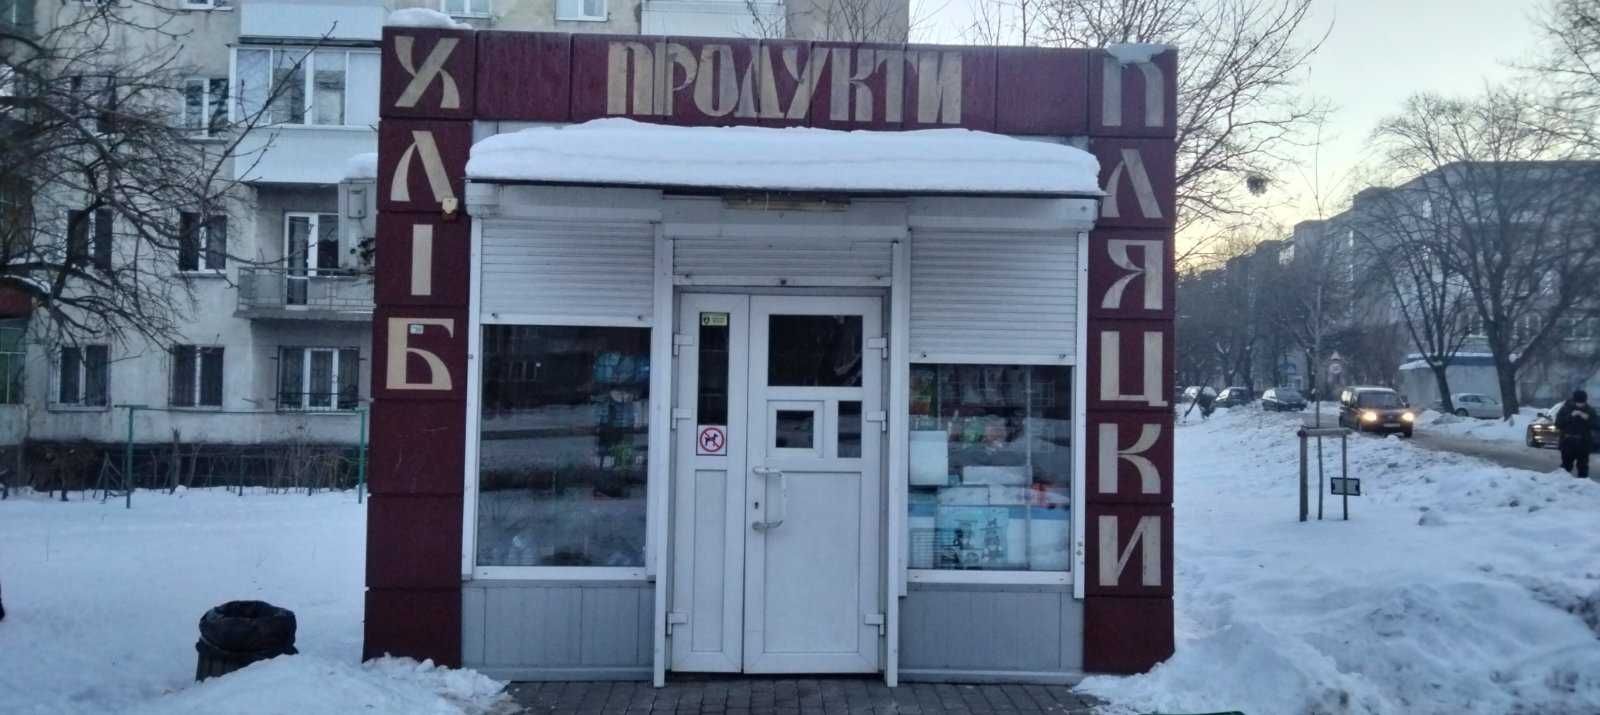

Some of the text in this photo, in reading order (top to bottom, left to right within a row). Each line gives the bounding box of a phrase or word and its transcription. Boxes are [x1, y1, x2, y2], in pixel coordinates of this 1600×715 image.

[386, 36, 460, 391] ХЛІБ
[605, 40, 963, 124] ПРОДУКТИ
[1098, 56, 1168, 587] ПЛЯЦКИ
